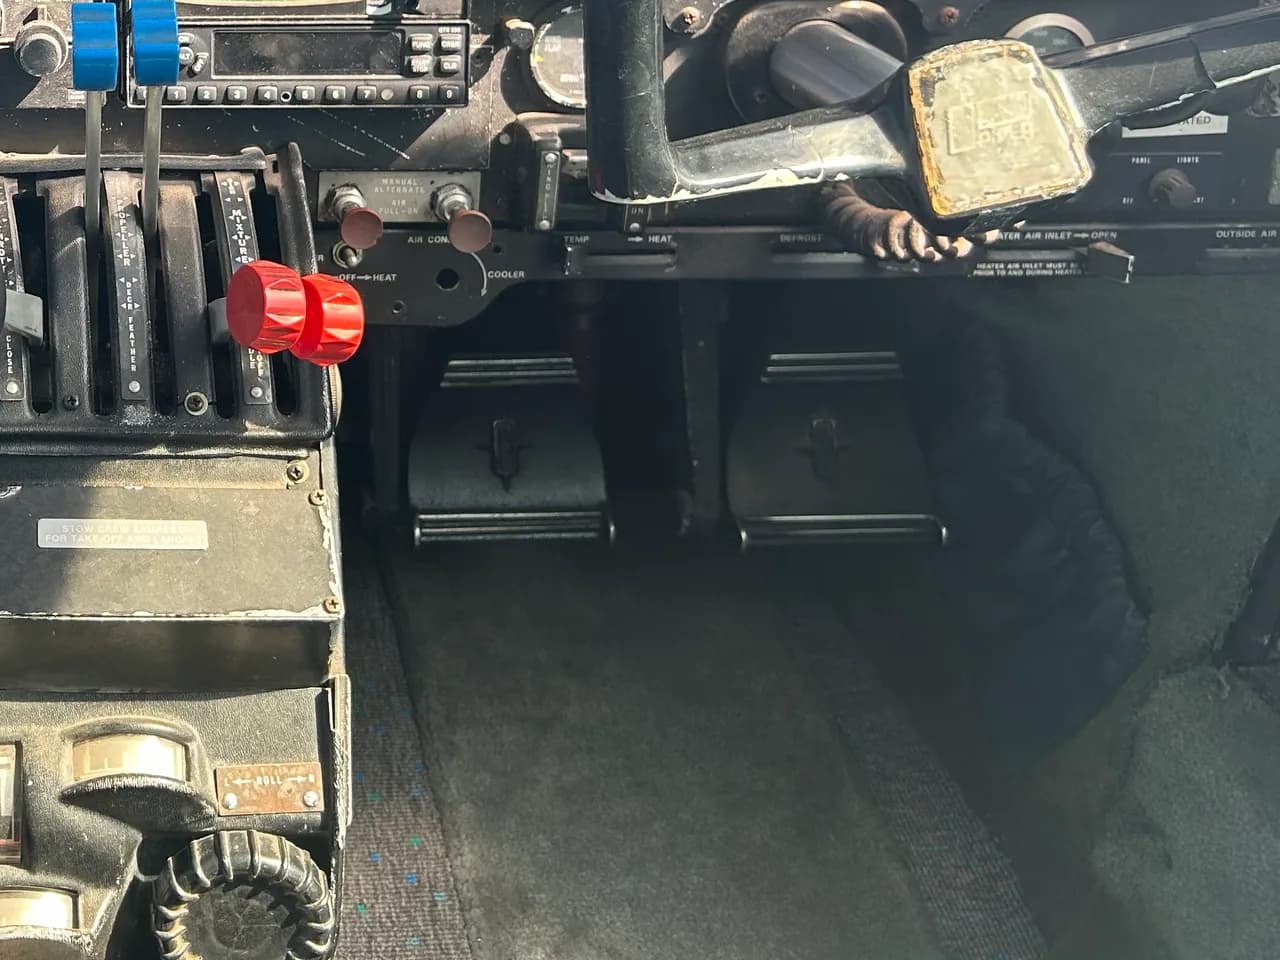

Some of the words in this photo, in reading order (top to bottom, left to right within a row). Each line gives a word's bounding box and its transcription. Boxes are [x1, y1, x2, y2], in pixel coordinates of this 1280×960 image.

[382, 178, 417, 186] MANUAL
[232, 210, 248, 263] MIXTURE
[1216, 230, 1256, 238] OUTSIDE
[649, 235, 671, 243] HEAT
[128, 317, 137, 372] FEATHER
[256, 776, 282, 784] ROLL
